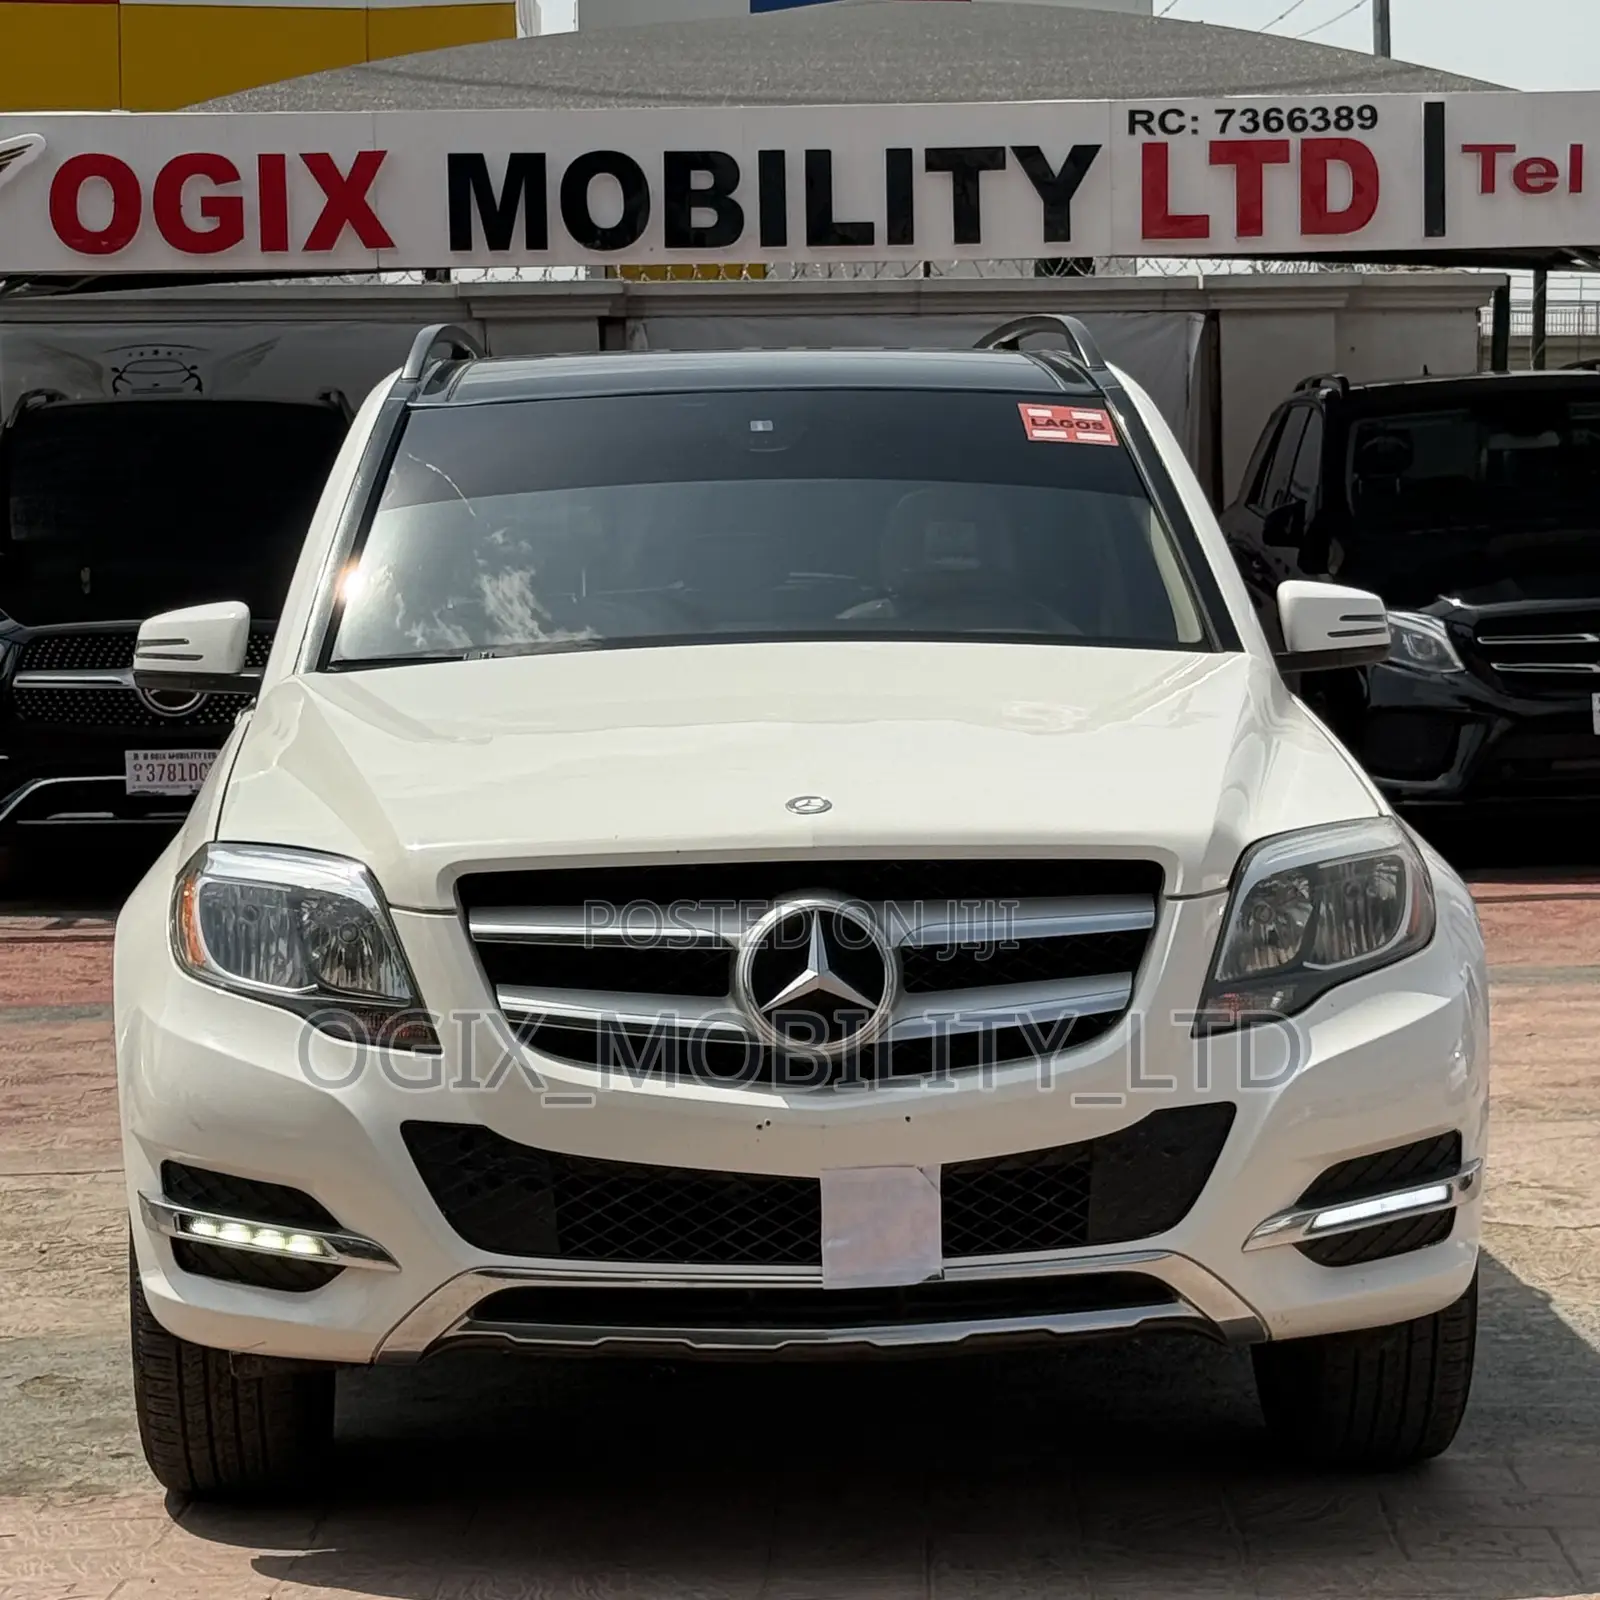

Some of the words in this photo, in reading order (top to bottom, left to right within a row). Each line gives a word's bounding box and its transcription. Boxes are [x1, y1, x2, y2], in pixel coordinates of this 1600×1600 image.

[1128, 109, 1200, 136] RC:
[1214, 105, 1379, 133] 7366389
[1461, 143, 1583, 195] Tel
[48, 150, 396, 256] OGIX
[447, 144, 1102, 252] MOBILITY
[1141, 138, 1380, 239] LTD
[1030, 418, 1106, 430] LAGOS
